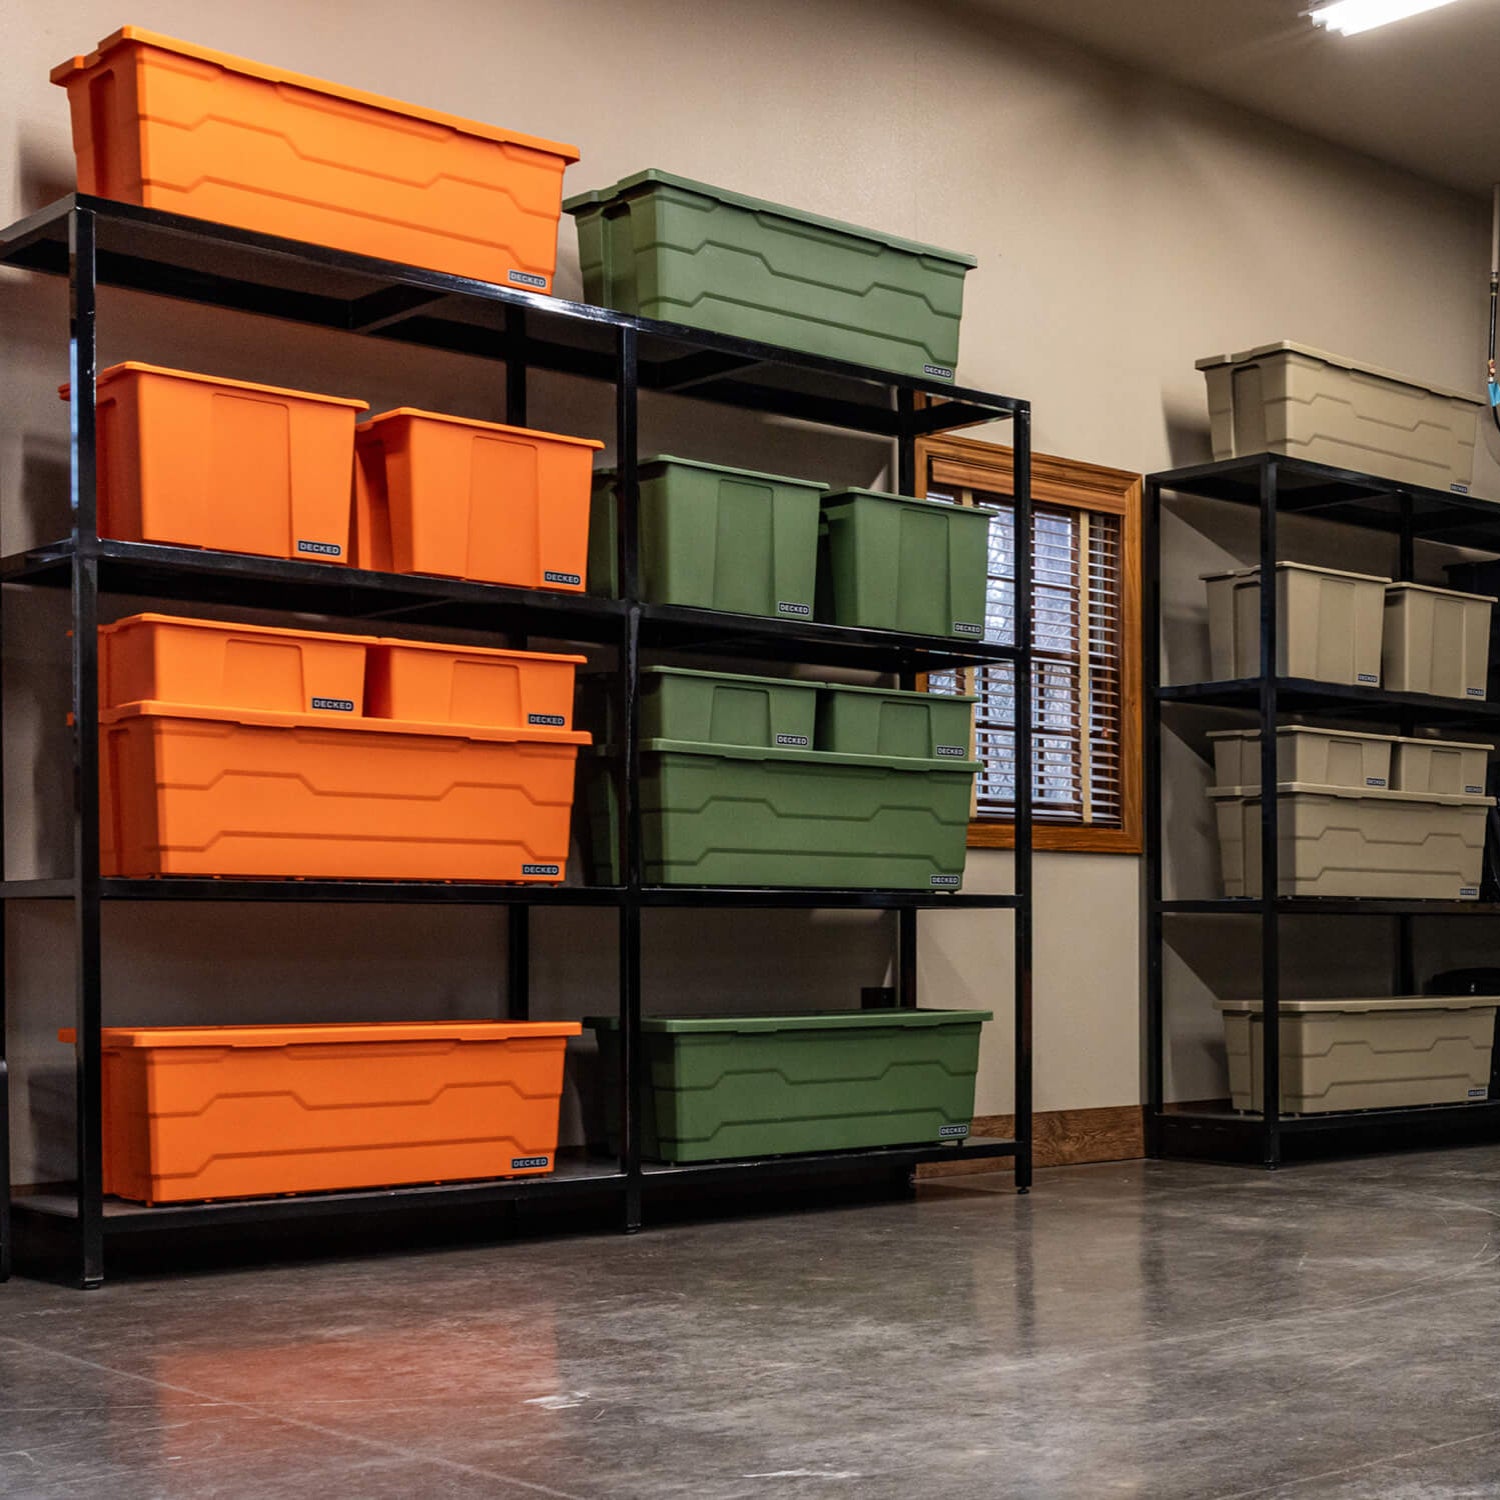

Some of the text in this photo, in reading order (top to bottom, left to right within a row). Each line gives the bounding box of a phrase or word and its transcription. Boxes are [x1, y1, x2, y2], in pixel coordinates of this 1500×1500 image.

[510, 272, 545, 286] DECKED
[925, 366, 951, 377] DECKED
[299, 543, 340, 554] DECKED
[546, 573, 580, 584] DECKED
[780, 604, 808, 614] DECKED
[955, 624, 980, 633] DECKED
[313, 699, 352, 710] DECKED
[529, 715, 564, 725] DECKED
[778, 736, 807, 745] DECKED
[937, 747, 963, 755] DECKED
[523, 866, 558, 874] DECKED
[513, 1158, 547, 1167] DECKED
